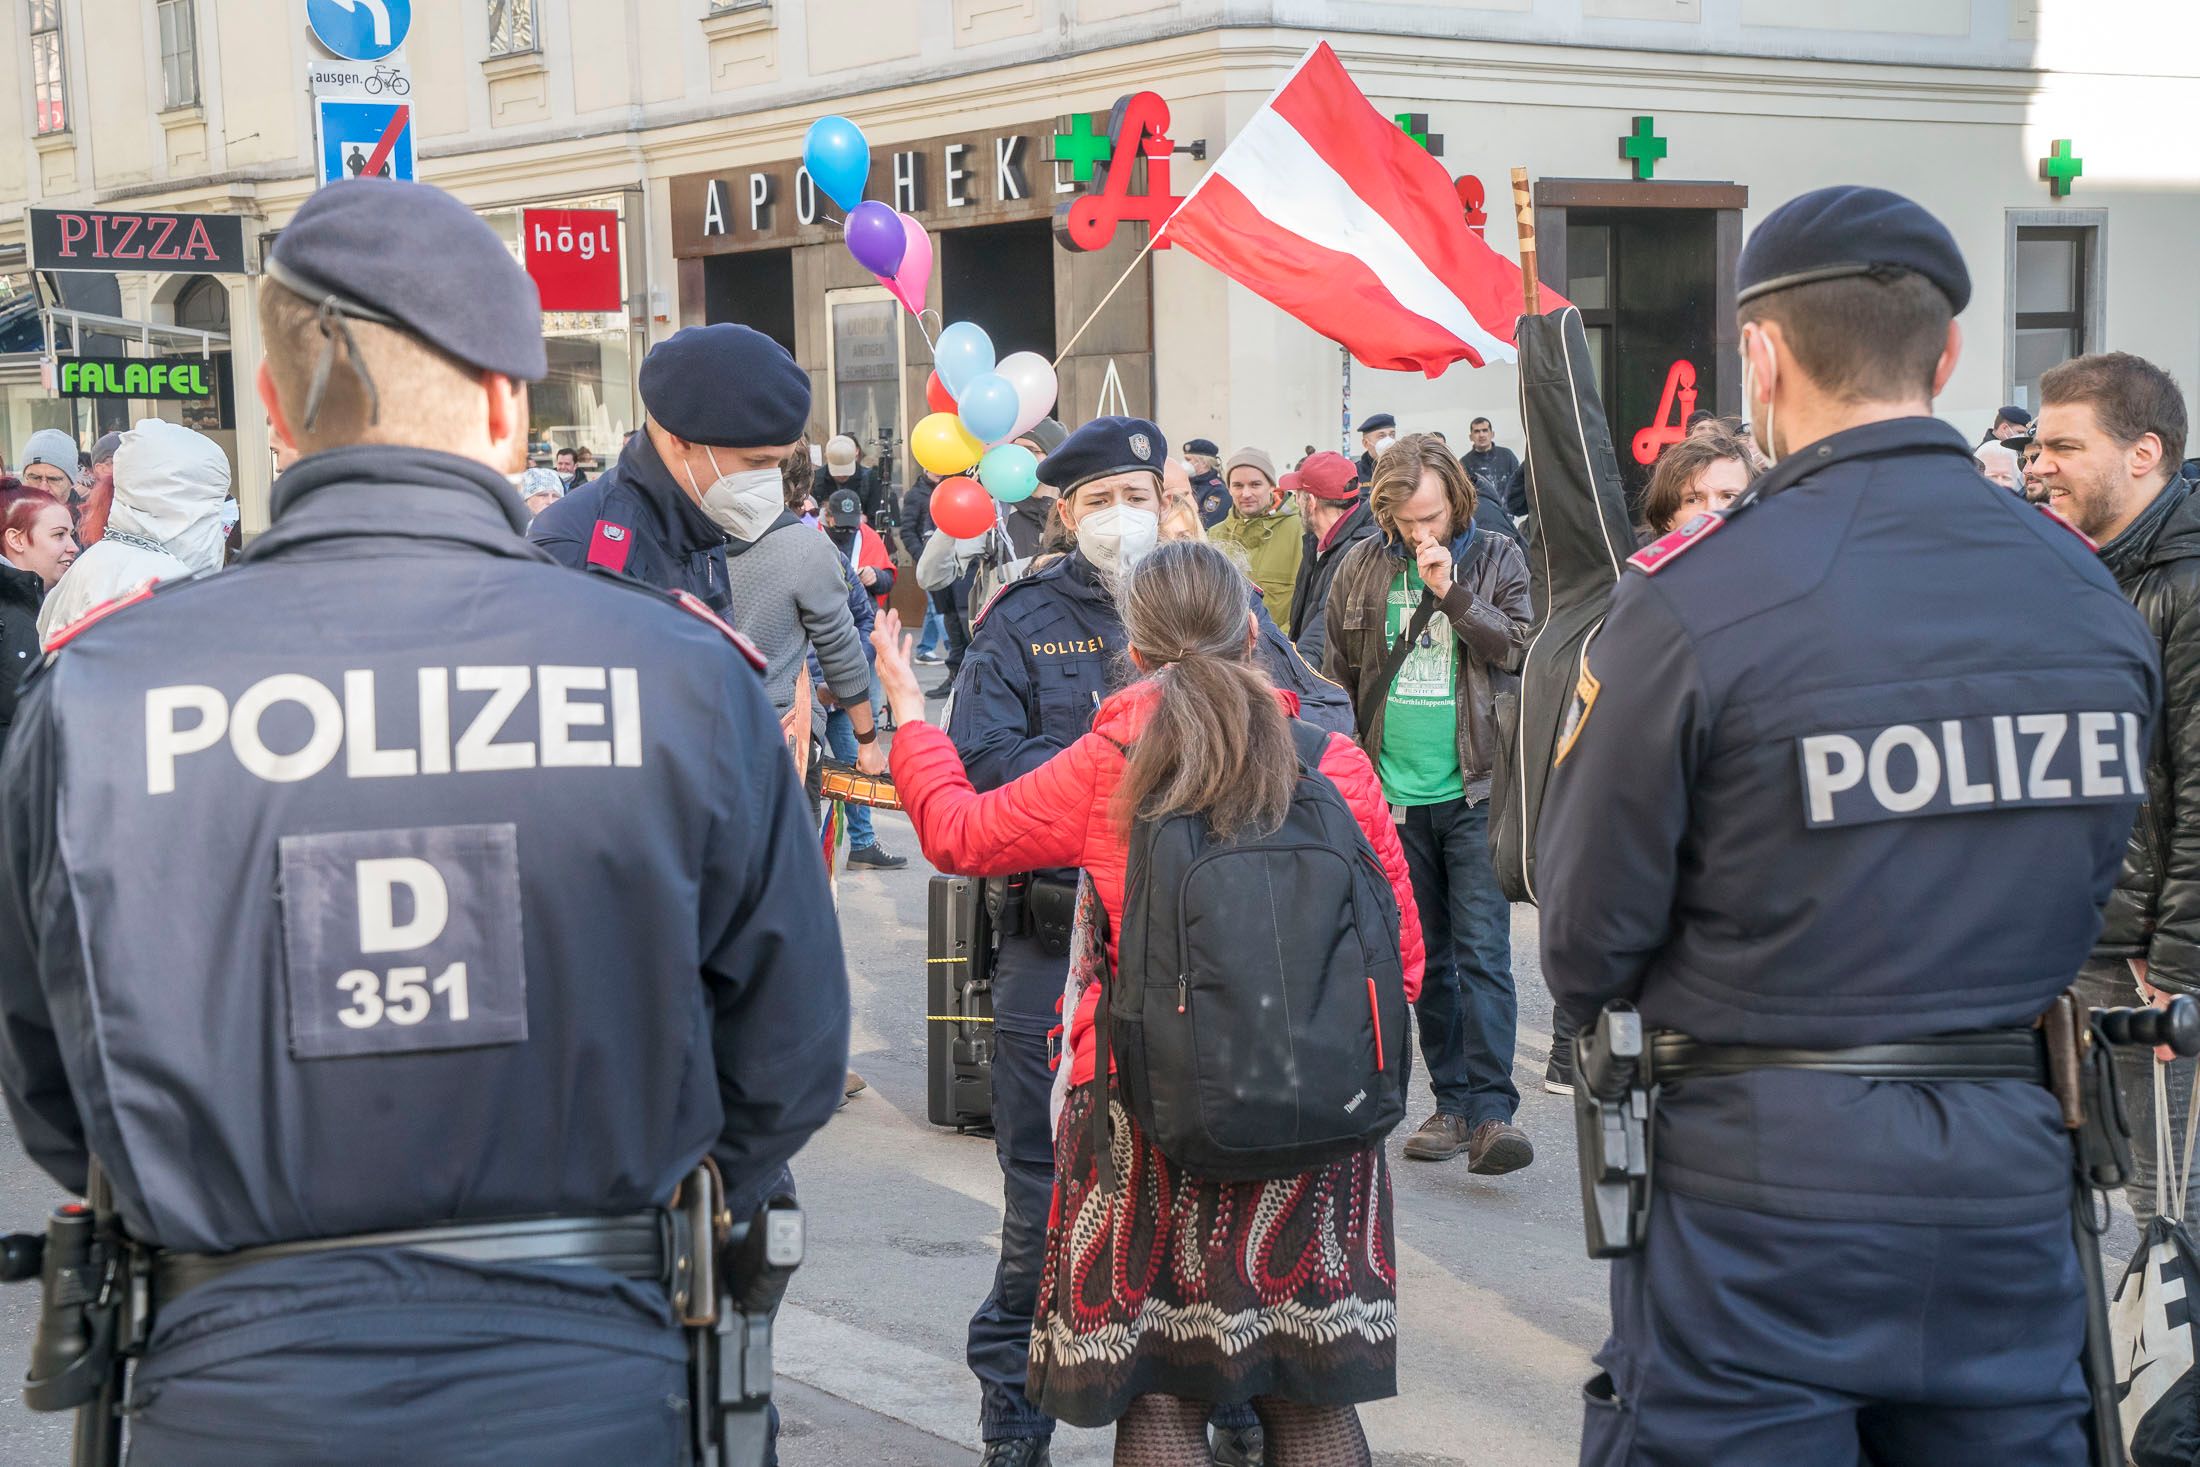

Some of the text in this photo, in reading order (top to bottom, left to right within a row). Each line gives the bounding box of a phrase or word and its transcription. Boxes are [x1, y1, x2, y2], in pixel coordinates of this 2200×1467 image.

[315, 71, 364, 87] ausgen.
[703, 128, 1075, 238] APOHEK
[57, 213, 220, 262] PIZZA
[62, 362, 210, 396] FALAFEL
[1031, 635, 1104, 656] POLIZEI
[145, 664, 643, 795] POLIZEI
[1802, 711, 2147, 823] POLIZEI
[356, 856, 450, 954] D
[336, 962, 470, 1030] 351
[1343, 1088, 1367, 1115] ThinkPad
